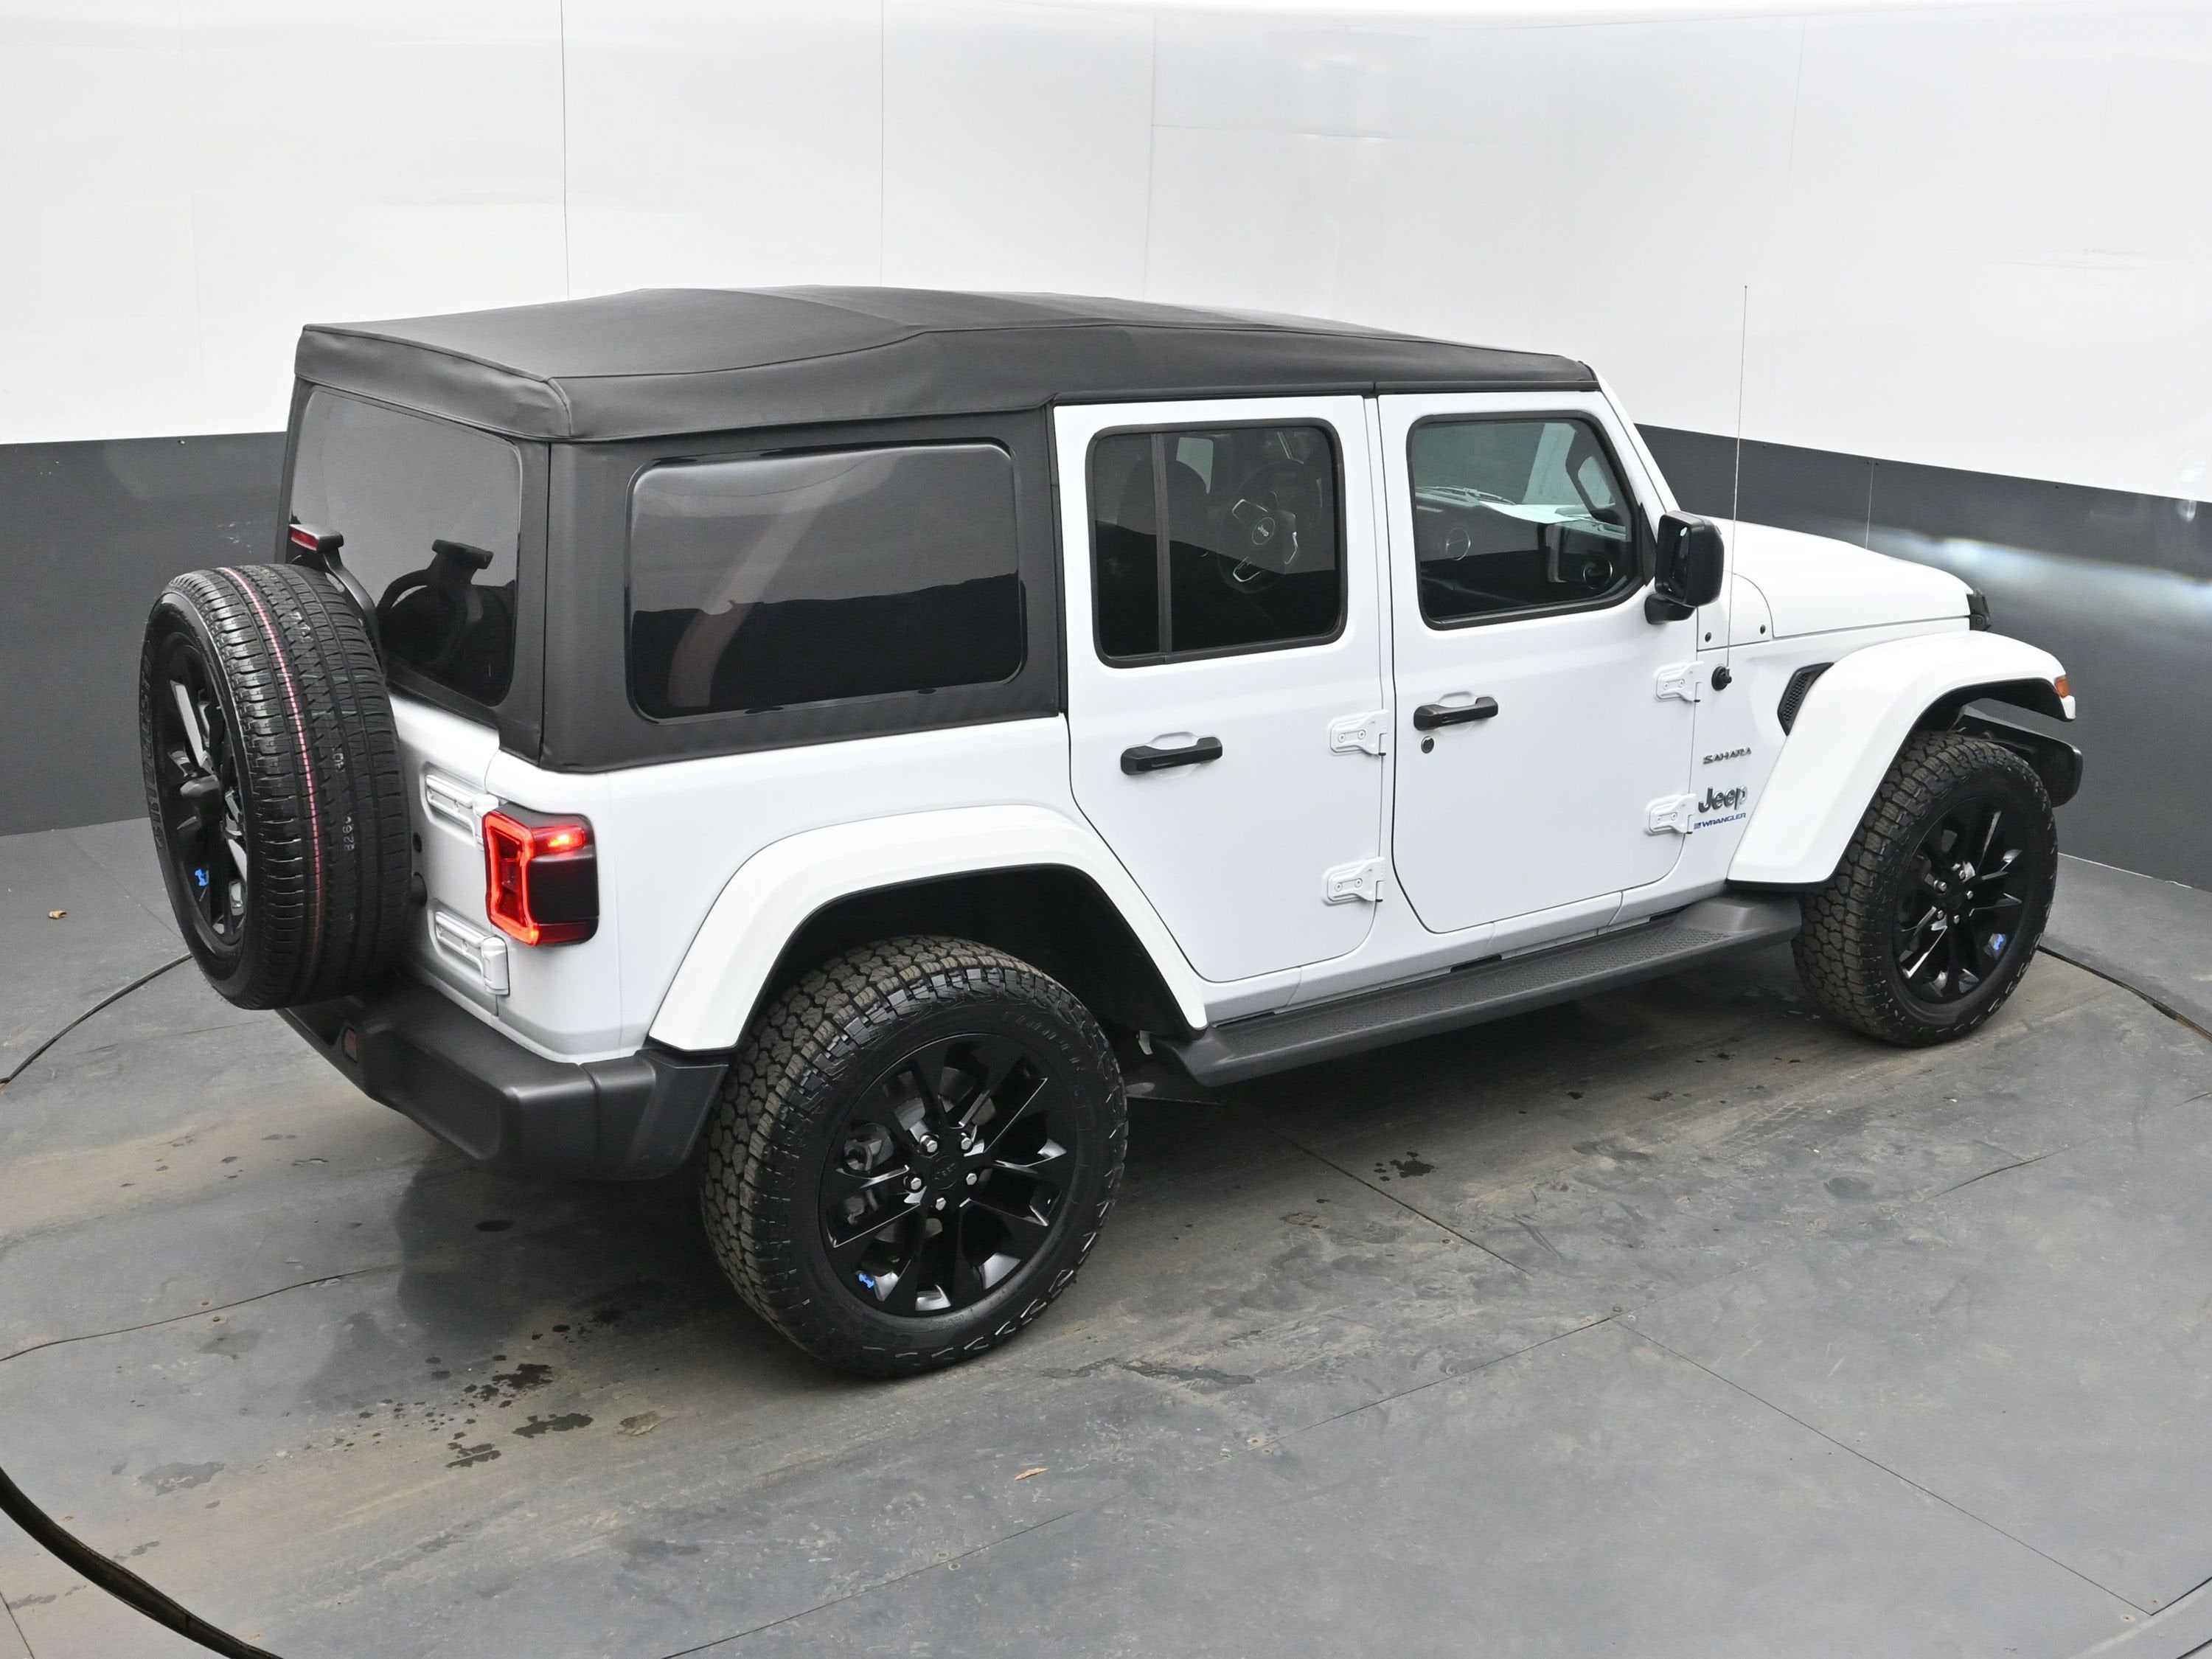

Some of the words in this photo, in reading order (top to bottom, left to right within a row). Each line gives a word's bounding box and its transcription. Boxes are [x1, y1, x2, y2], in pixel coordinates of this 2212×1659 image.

[1703, 747, 1752, 765] SAHARA
[1698, 786, 1748, 813] Jeep
[1702, 813, 1747, 827] WRANGLER
